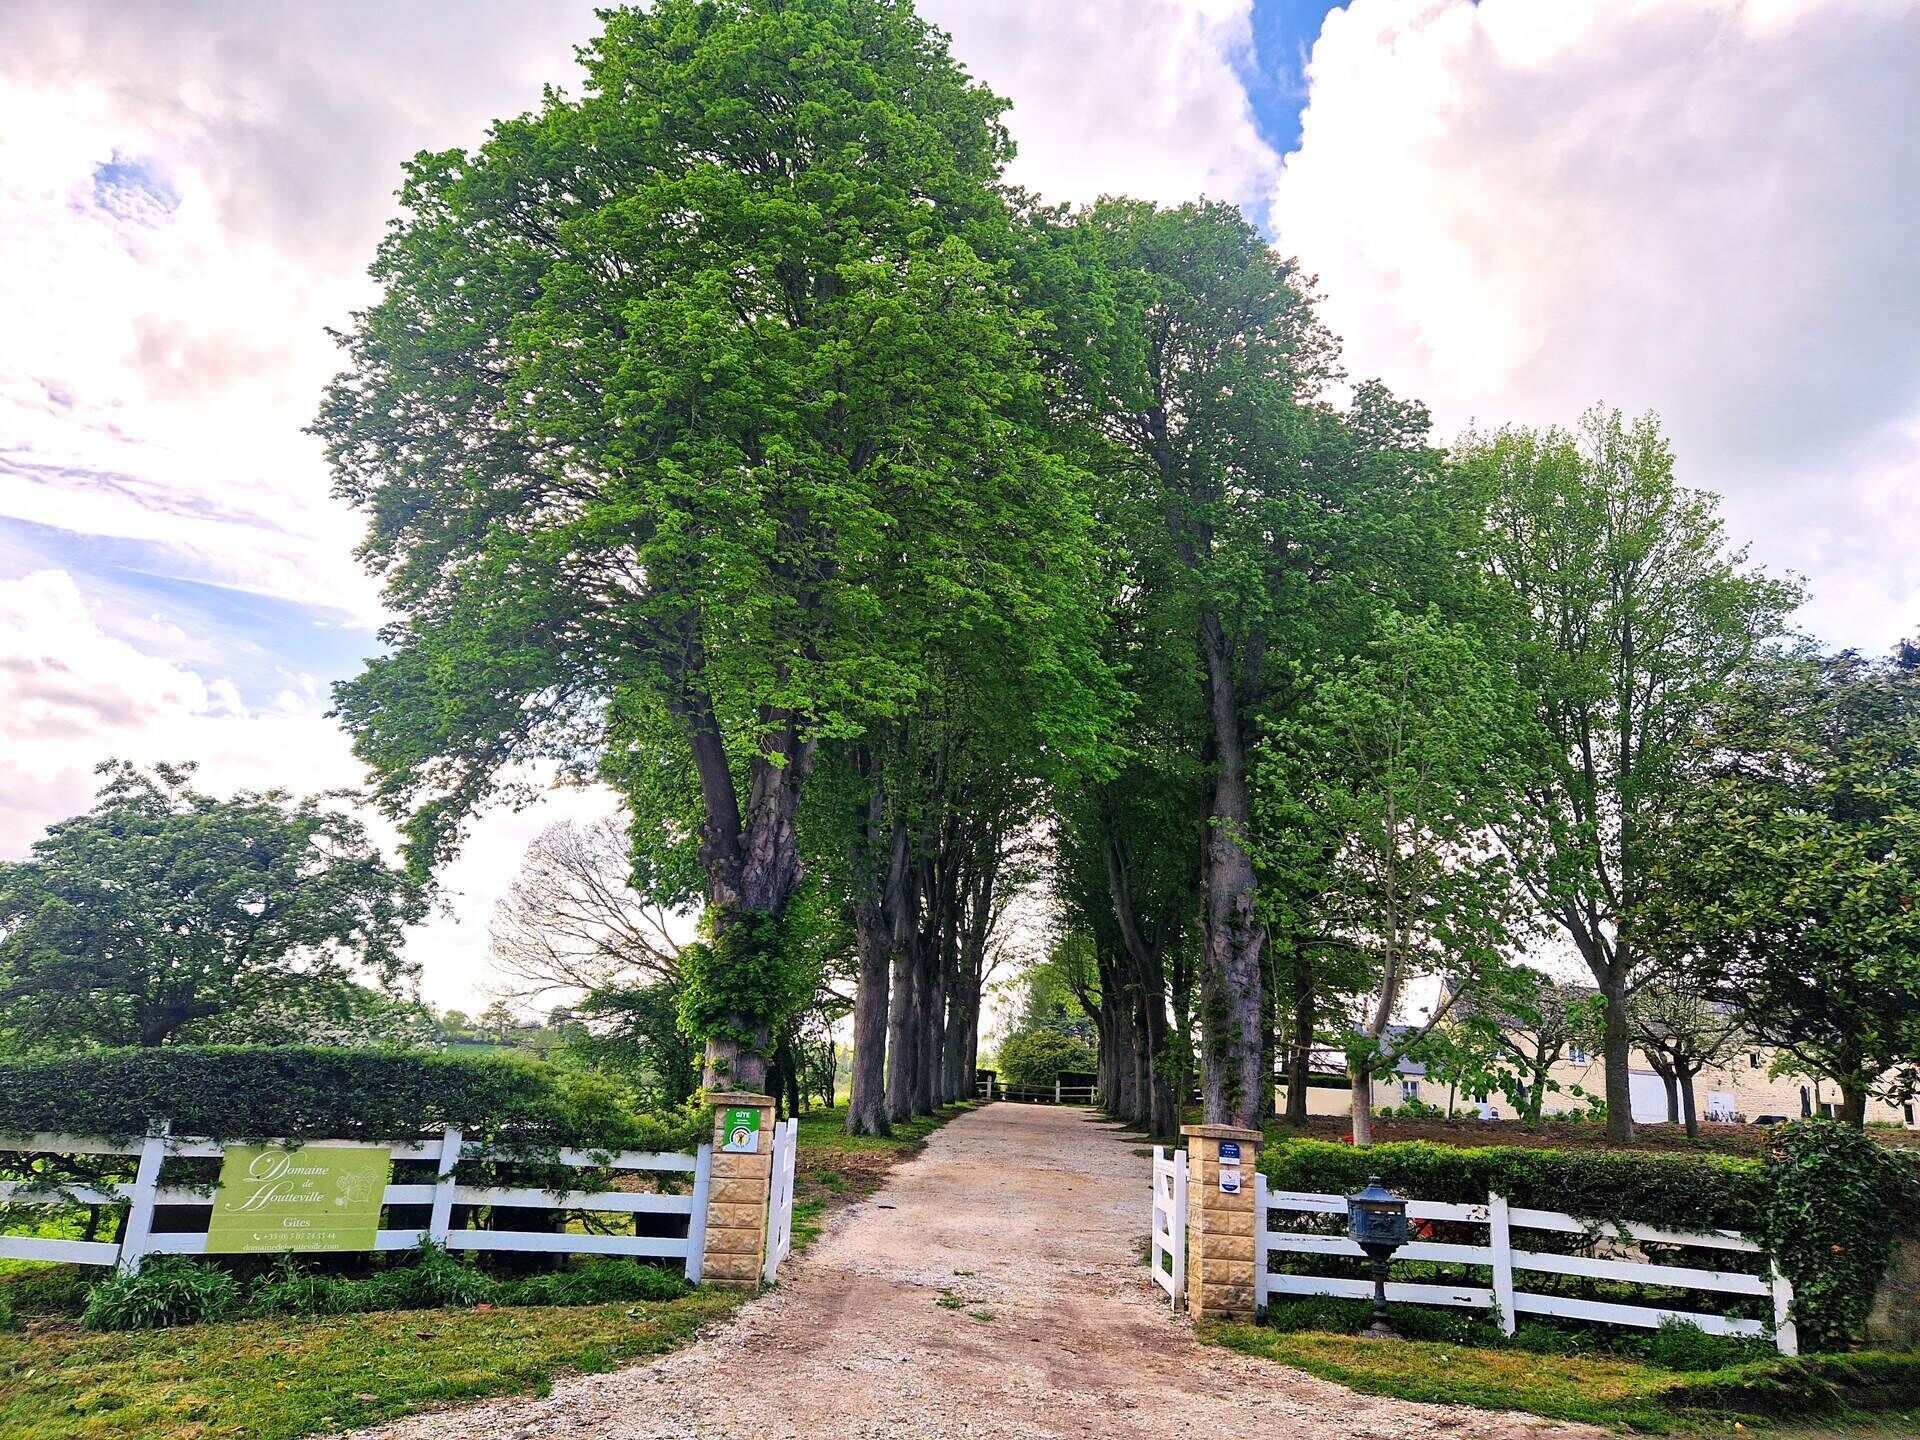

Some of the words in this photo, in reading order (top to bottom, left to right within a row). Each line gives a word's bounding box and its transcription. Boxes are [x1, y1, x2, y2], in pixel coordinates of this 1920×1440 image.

[242, 1150, 328, 1182] Domaine
[302, 1180, 314, 1188] de
[225, 1181, 324, 1212] Houtteville
[283, 1217, 310, 1228] Gîtes
